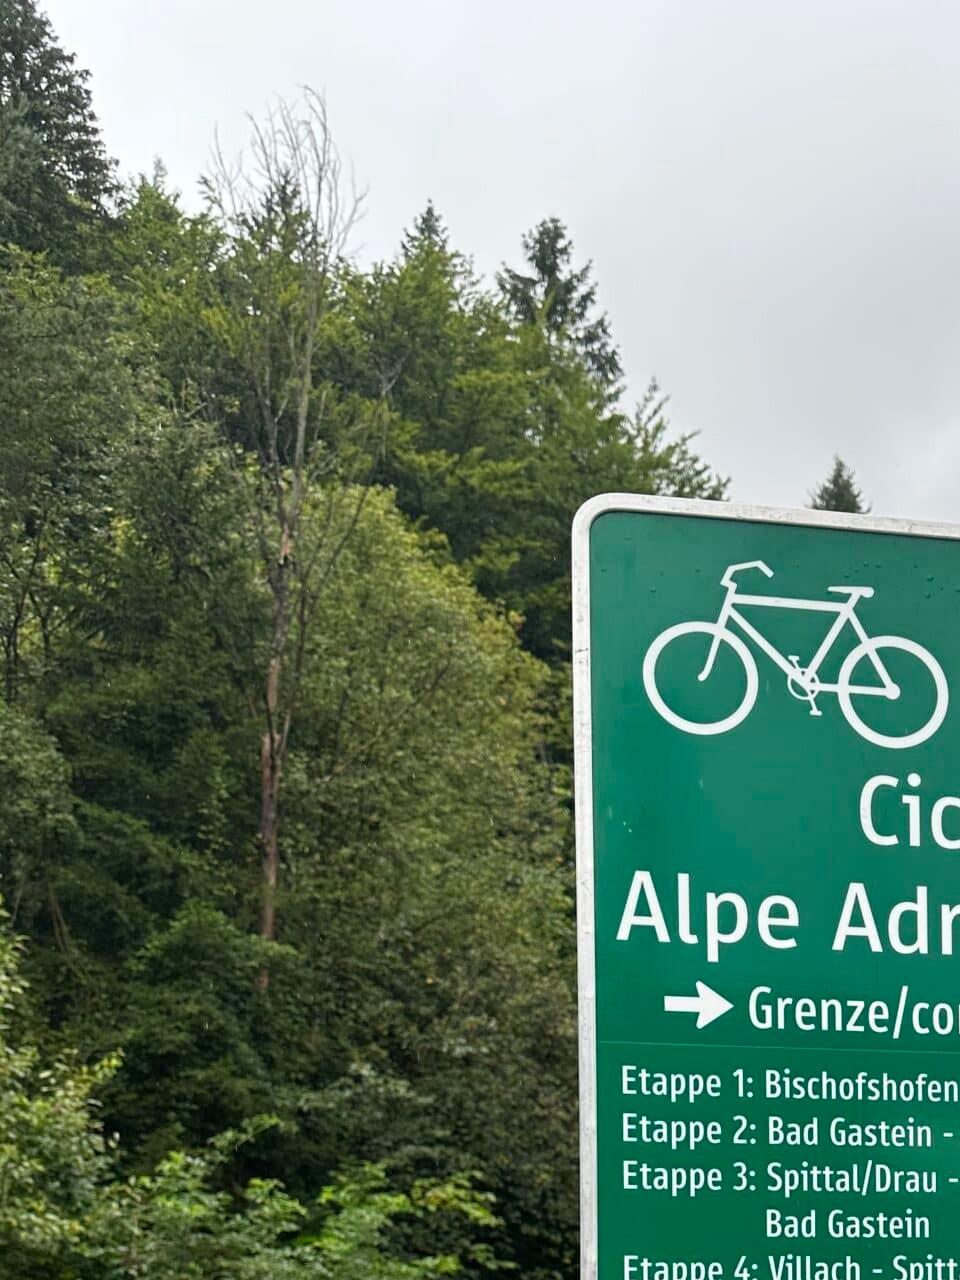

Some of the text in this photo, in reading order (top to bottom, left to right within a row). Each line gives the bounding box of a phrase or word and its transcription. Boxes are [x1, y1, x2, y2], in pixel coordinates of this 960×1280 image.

[617, 871, 799, 962] Alpe
[623, 1066, 720, 1102] Etappe
[734, 1069, 753, 1097] 1:
[766, 1069, 958, 1101] Bischofshofen
[623, 1113, 721, 1149] Etappe
[734, 1116, 755, 1144] 2:
[769, 1117, 817, 1145] Bad
[831, 1118, 931, 1146] Gastein
[624, 1161, 721, 1196] Etappe
[734, 1162, 755, 1190] 3:
[768, 1160, 936, 1197] Spittal/Drau
[767, 1209, 929, 1237] Bad Gastein
